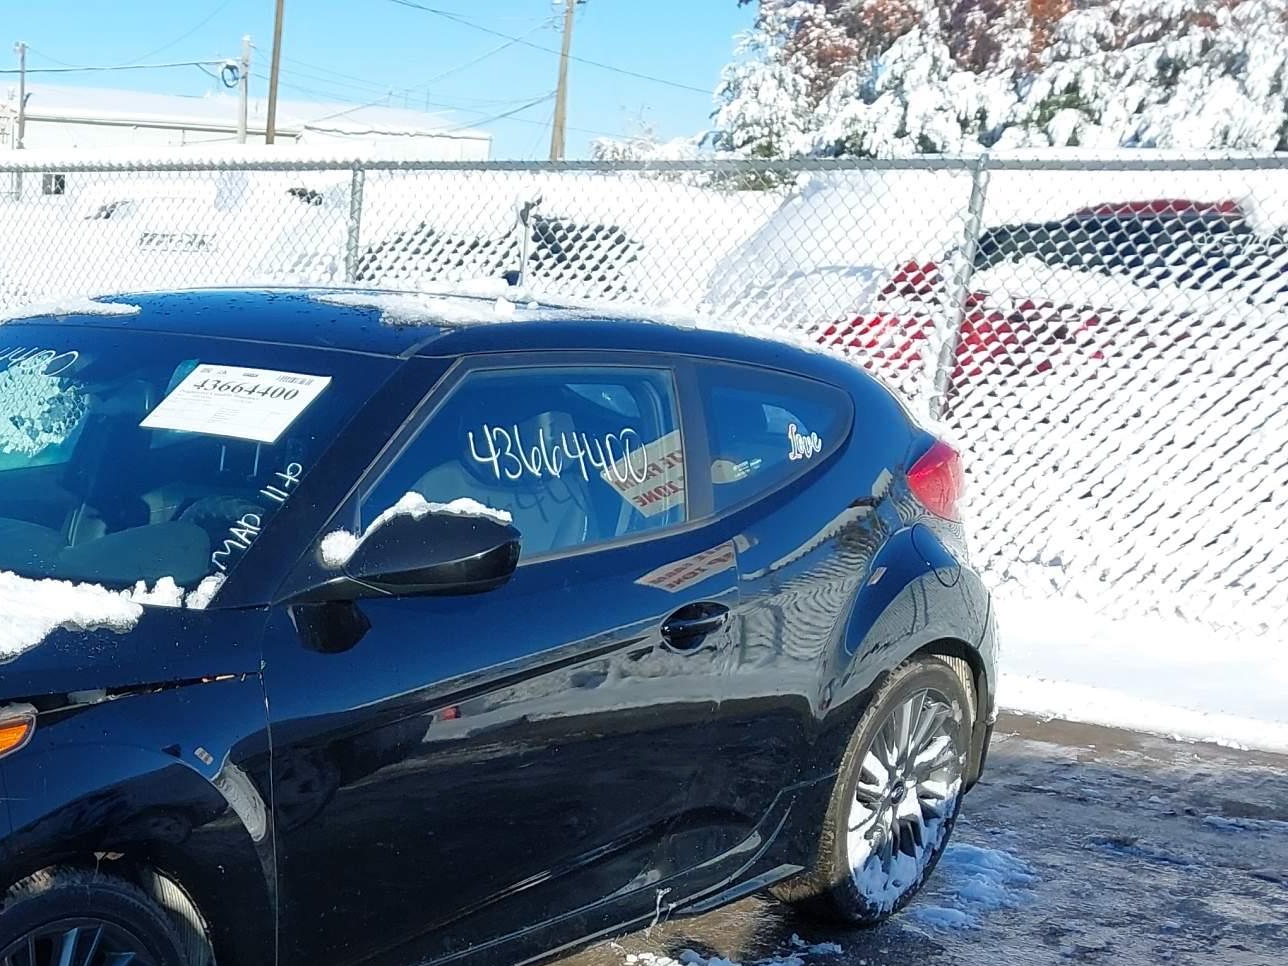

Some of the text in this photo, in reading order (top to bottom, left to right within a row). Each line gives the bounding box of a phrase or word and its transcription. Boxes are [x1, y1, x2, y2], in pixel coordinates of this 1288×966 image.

[192, 378, 300, 401] 43664400
[468, 423, 648, 483] 43664400
[212, 513, 262, 571] MAD
